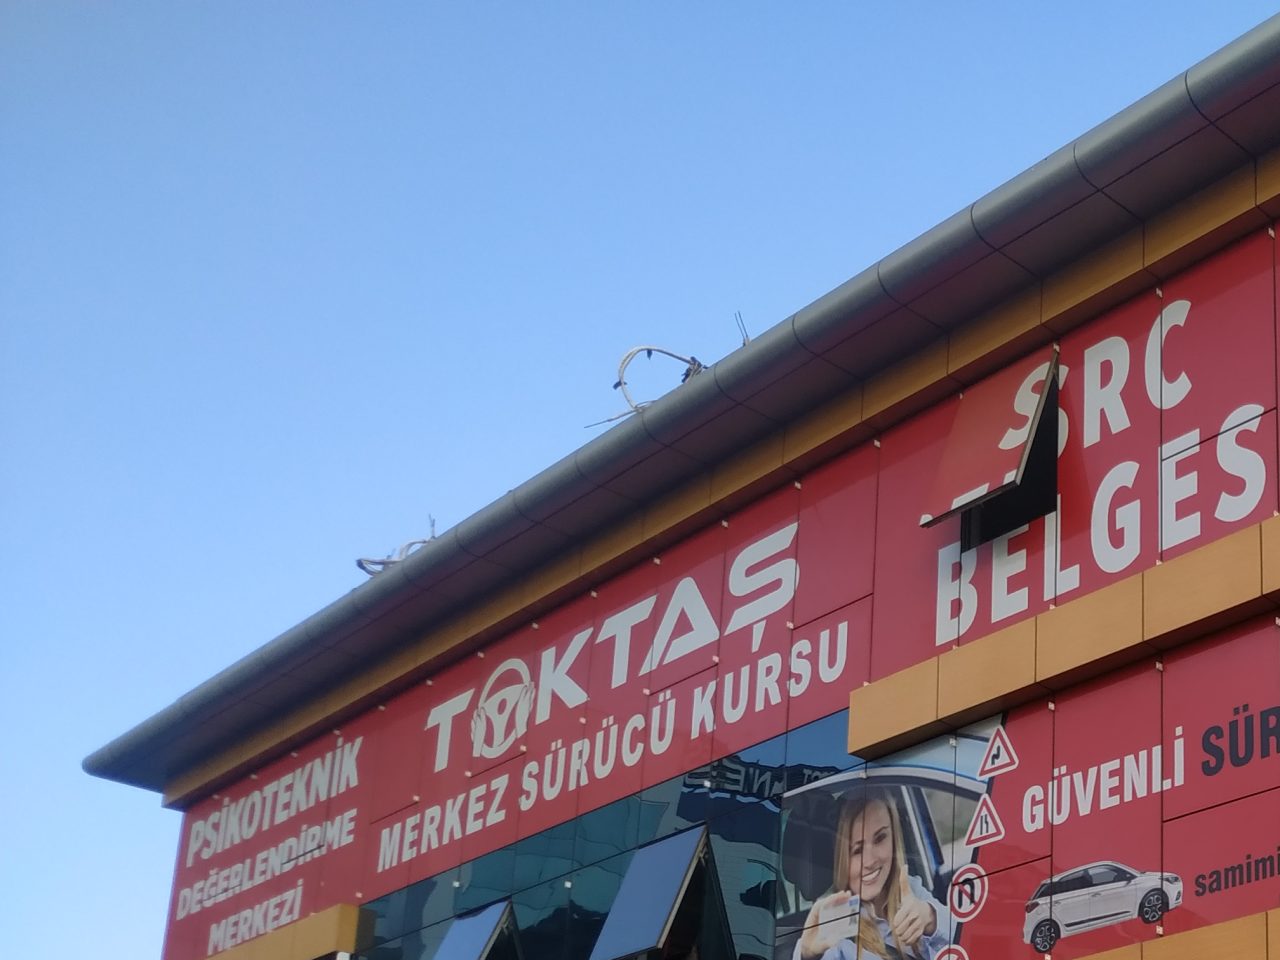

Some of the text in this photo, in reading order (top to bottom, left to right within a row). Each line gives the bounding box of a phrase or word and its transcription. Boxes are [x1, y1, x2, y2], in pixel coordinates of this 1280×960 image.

[998, 300, 1192, 460] SRC
[425, 522, 800, 772] TOKTAŞ
[186, 736, 363, 868] PSİKOTEKNİK
[377, 621, 848, 874] MERKEZ SÜRÜCÜ KURSU
[1022, 725, 1185, 833] GÜVENLİ
[176, 808, 358, 920] DEĞERLENDİRME
[207, 879, 304, 956] MERKEZİ
